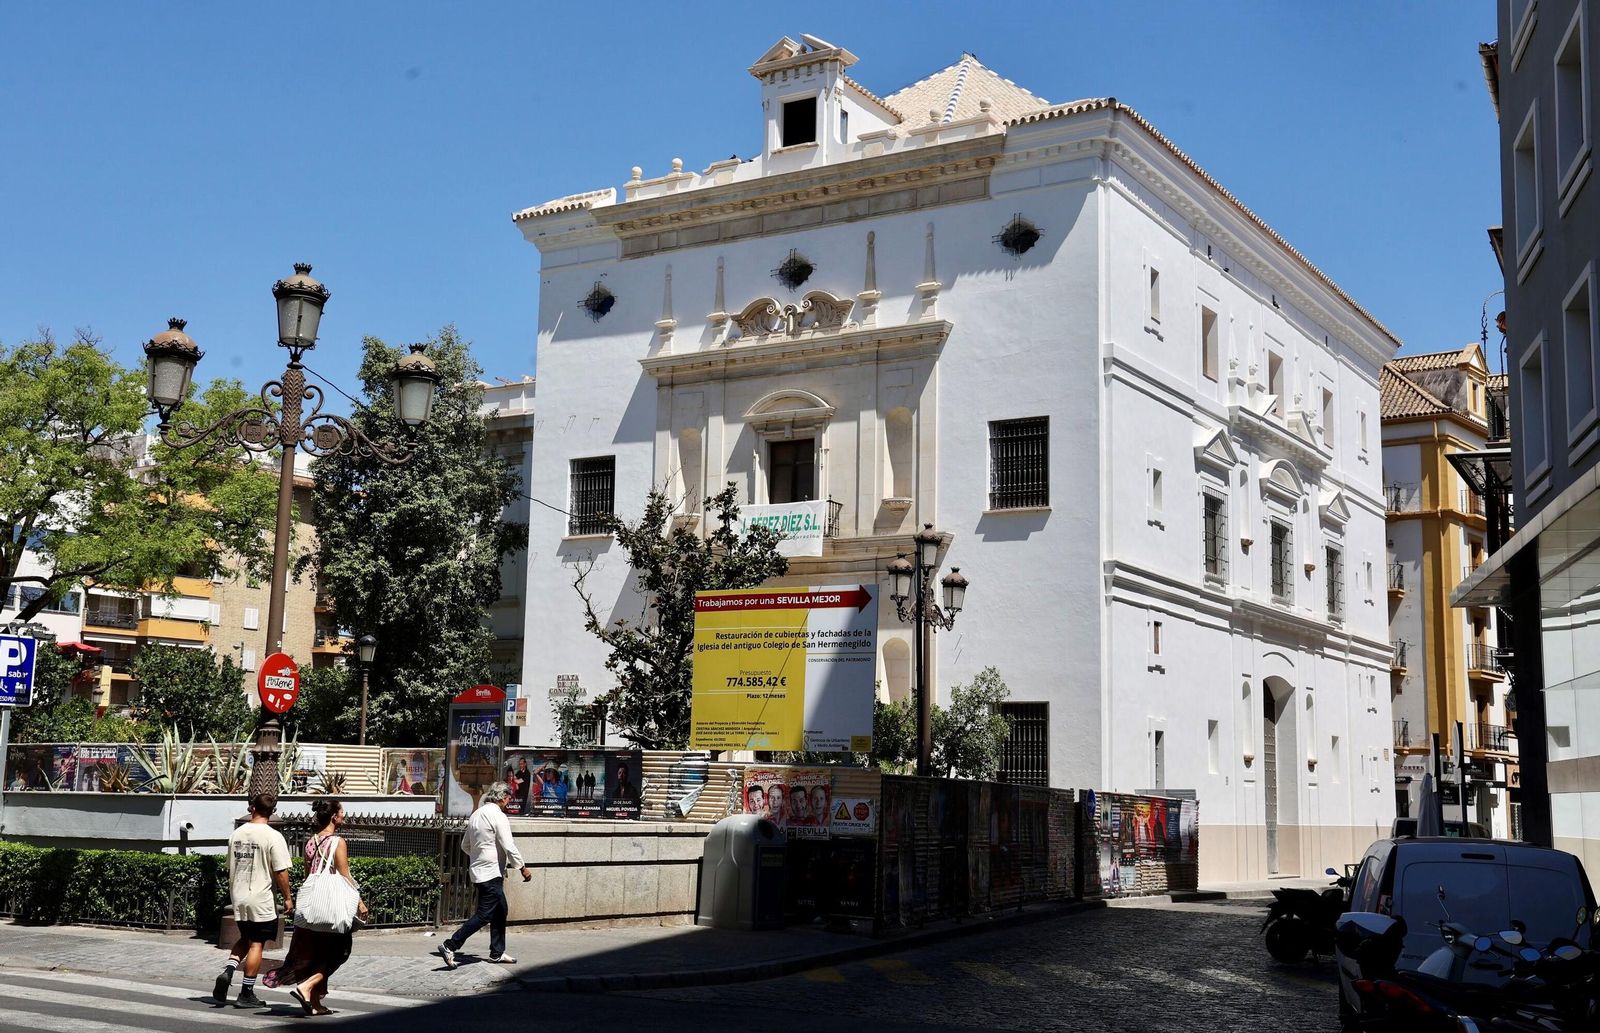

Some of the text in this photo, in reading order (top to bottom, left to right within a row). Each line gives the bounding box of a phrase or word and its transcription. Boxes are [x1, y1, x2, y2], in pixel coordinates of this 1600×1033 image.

[804, 514, 820, 531] S.L.
[698, 594, 840, 608] Trabajamos por una SEVILLA MEJOR
[715, 631, 764, 640] Restauración
[774, 630, 810, 639] cubiertas
[817, 630, 851, 638] fachadas
[852, 630, 863, 638] de
[697, 643, 720, 653] Iglesia
[734, 642, 761, 652] antiguo
[762, 642, 790, 651] Colegio
[791, 641, 801, 649] de
[802, 641, 815, 649] San
[817, 640, 871, 650] Hermenegildo
[0, 639, 27, 676] P
[726, 677, 787, 688] 774.585,42 €
[507, 700, 514, 710] P
